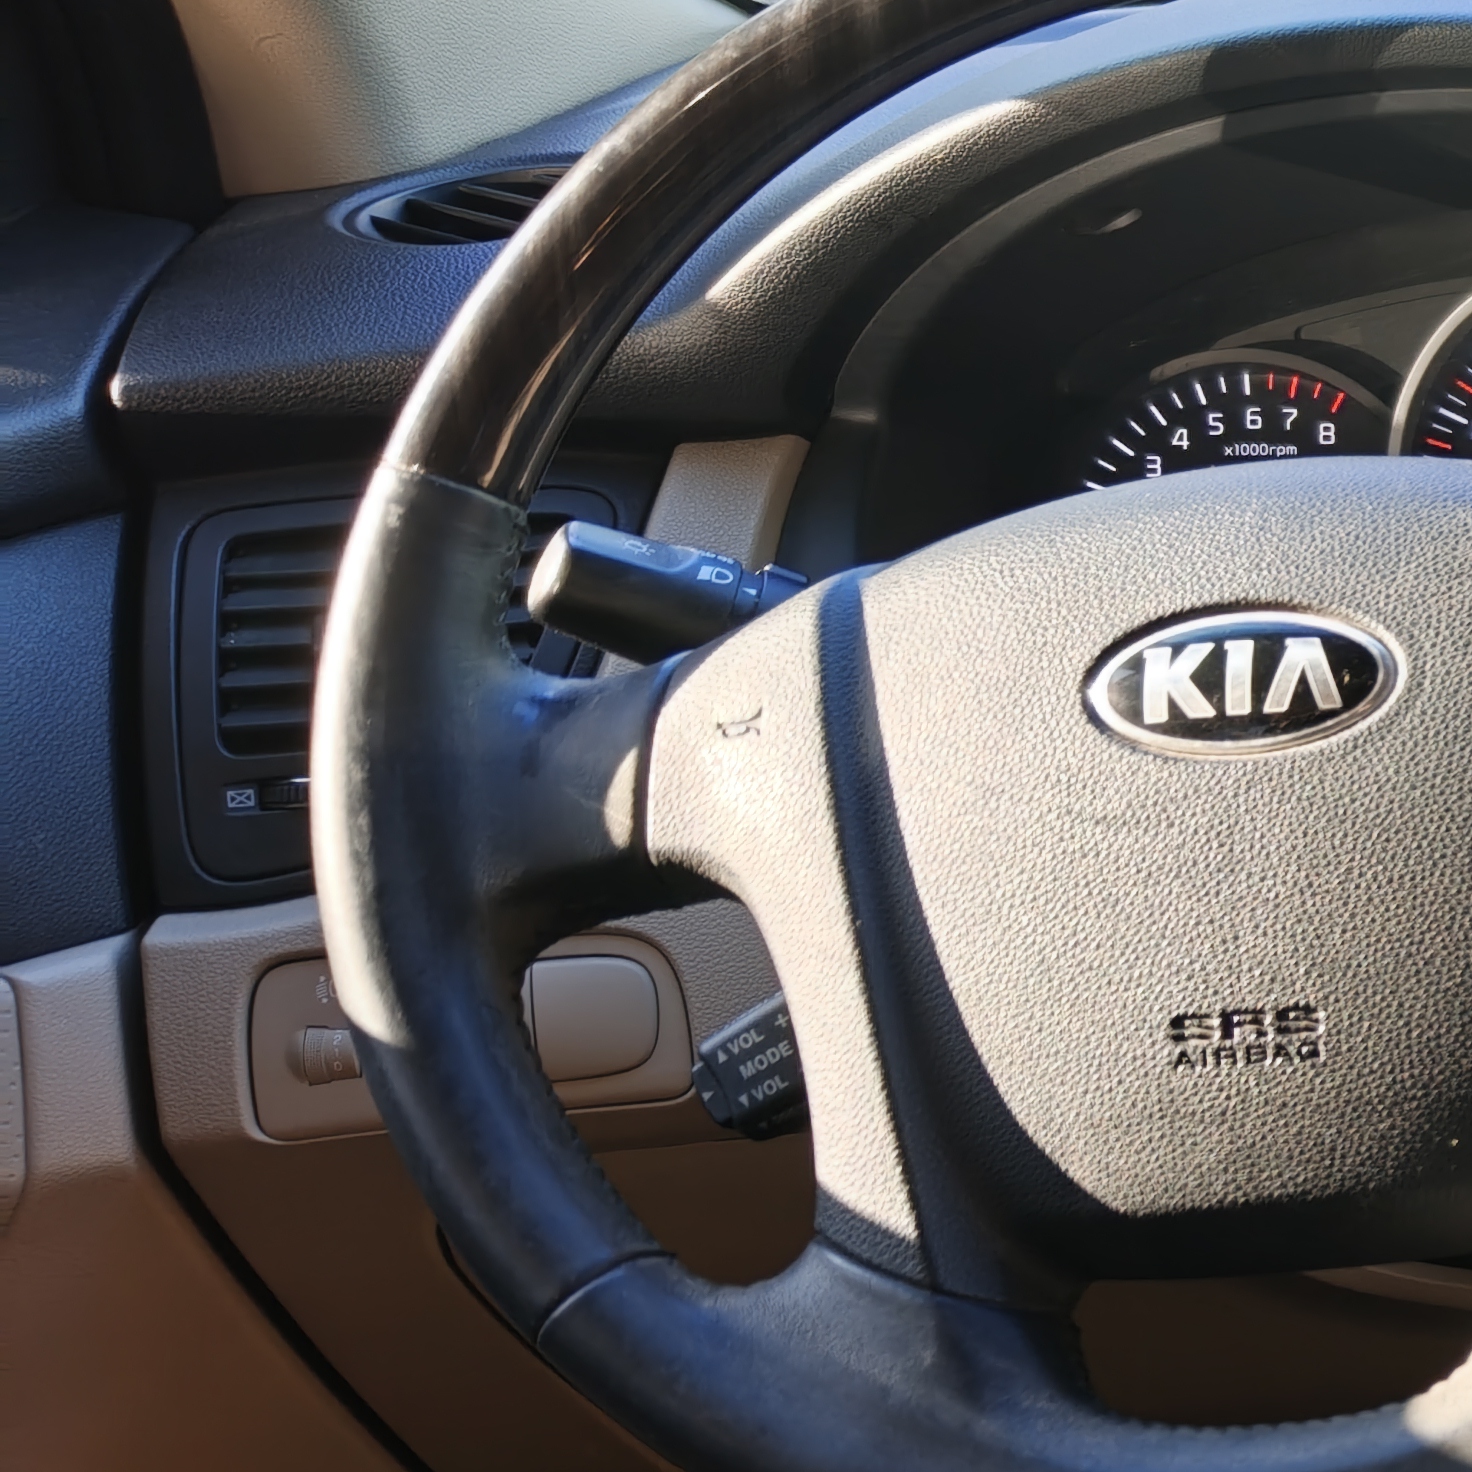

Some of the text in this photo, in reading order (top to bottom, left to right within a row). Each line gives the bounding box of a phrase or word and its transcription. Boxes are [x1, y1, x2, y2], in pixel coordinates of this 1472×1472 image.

[1208, 413, 1225, 436] 5
[1245, 407, 1263, 430] 6
[1282, 408, 1299, 431] 7
[1171, 428, 1190, 451] 4
[1318, 422, 1337, 445] 8
[1224, 443, 1298, 458] x1000rpm
[1144, 455, 1162, 479] 3
[1142, 636, 1344, 725] KIA
[1168, 1005, 1326, 1043] SRS
[727, 1028, 766, 1056] VOL
[738, 1039, 795, 1081] MODE
[1172, 1041, 1326, 1071] AIRBAG
[750, 1074, 790, 1102] VOL
